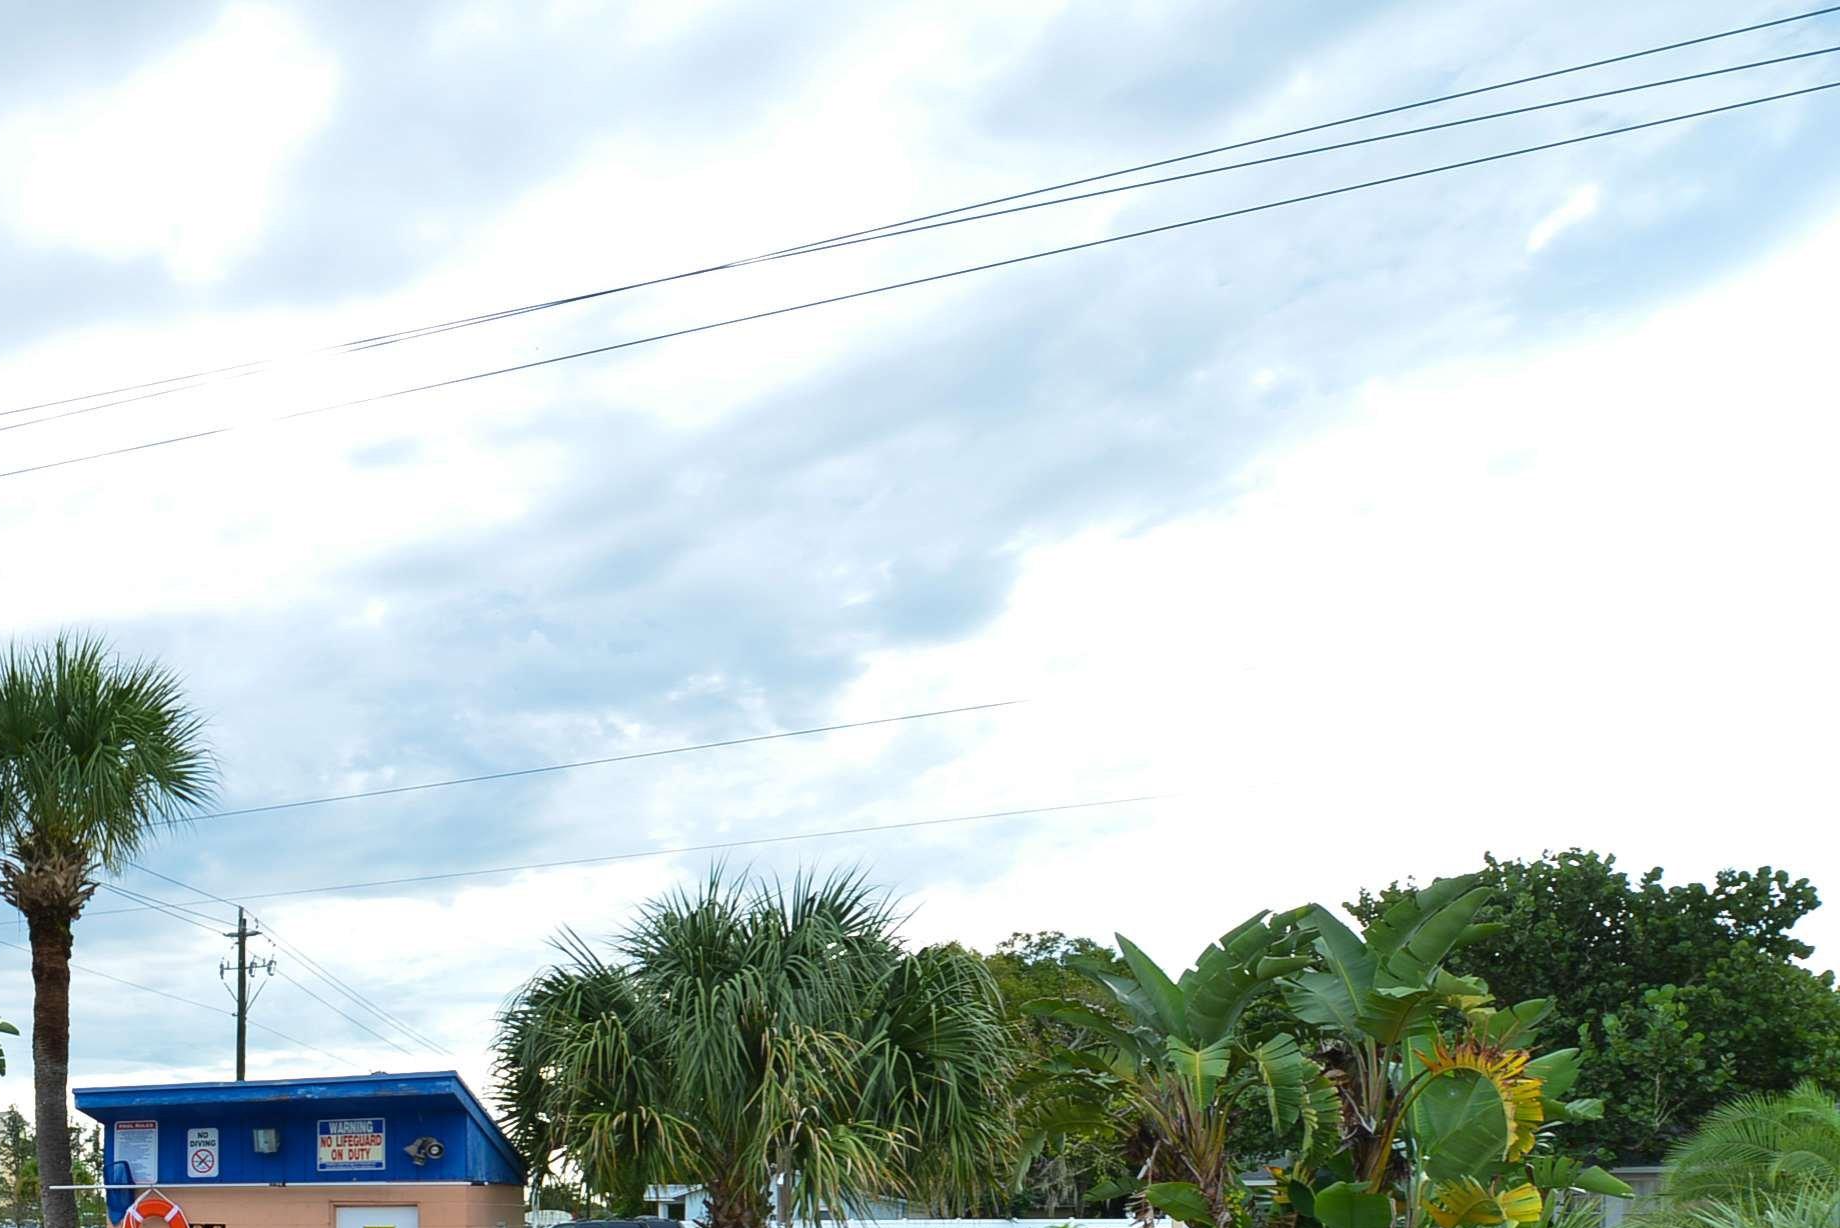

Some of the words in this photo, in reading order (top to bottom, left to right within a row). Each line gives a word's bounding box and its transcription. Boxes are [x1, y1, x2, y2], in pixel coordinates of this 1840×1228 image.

[329, 1121, 373, 1134] WARNING
[189, 1139, 216, 1147] DIVING
[320, 1136, 332, 1148] NO
[336, 1134, 382, 1147] LIFEGUARD
[331, 1149, 344, 1160] ON
[348, 1148, 370, 1160] DUTY
